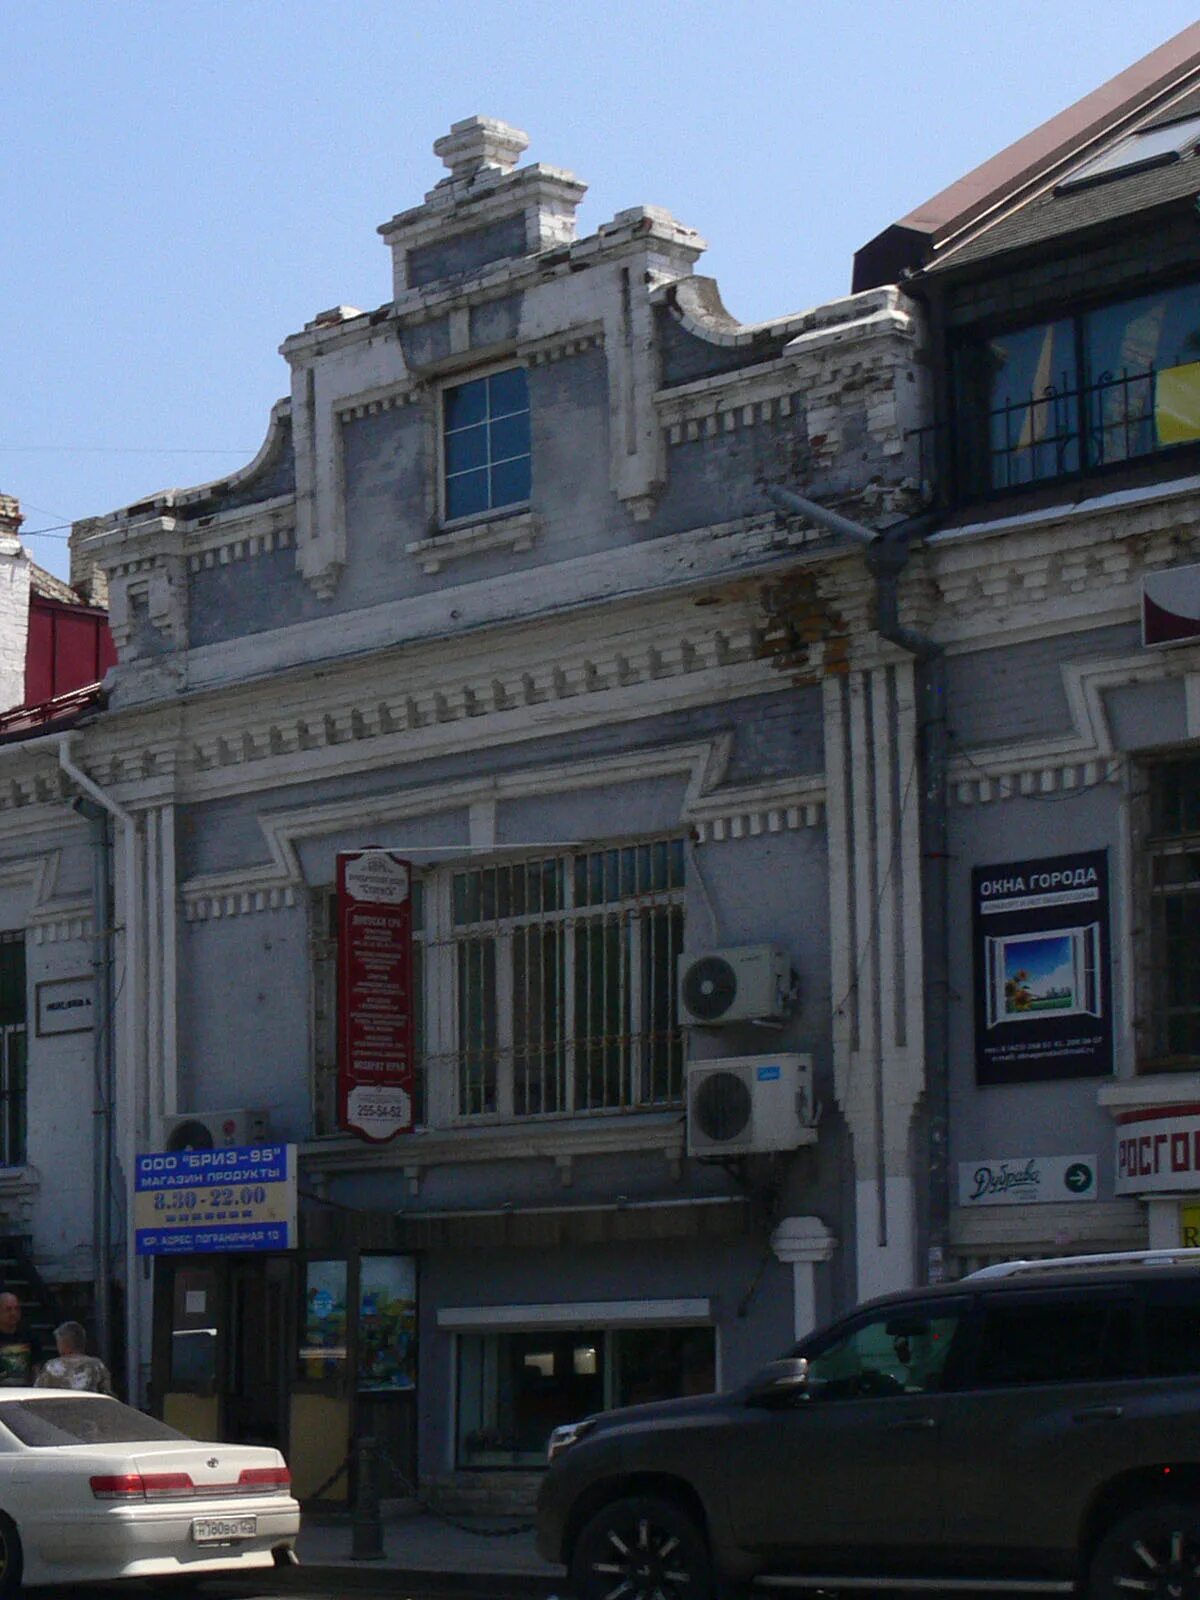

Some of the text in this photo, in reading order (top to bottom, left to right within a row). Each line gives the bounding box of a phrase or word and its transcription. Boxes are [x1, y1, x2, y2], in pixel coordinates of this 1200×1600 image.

[980, 866, 1098, 896] ОКНА ГОРОДА
[141, 1156, 178, 1171] ООО
[1119, 1130, 1200, 1178] РОСГО
[141, 1168, 281, 1187] МАГАЗИН ПРОДУКТЫ
